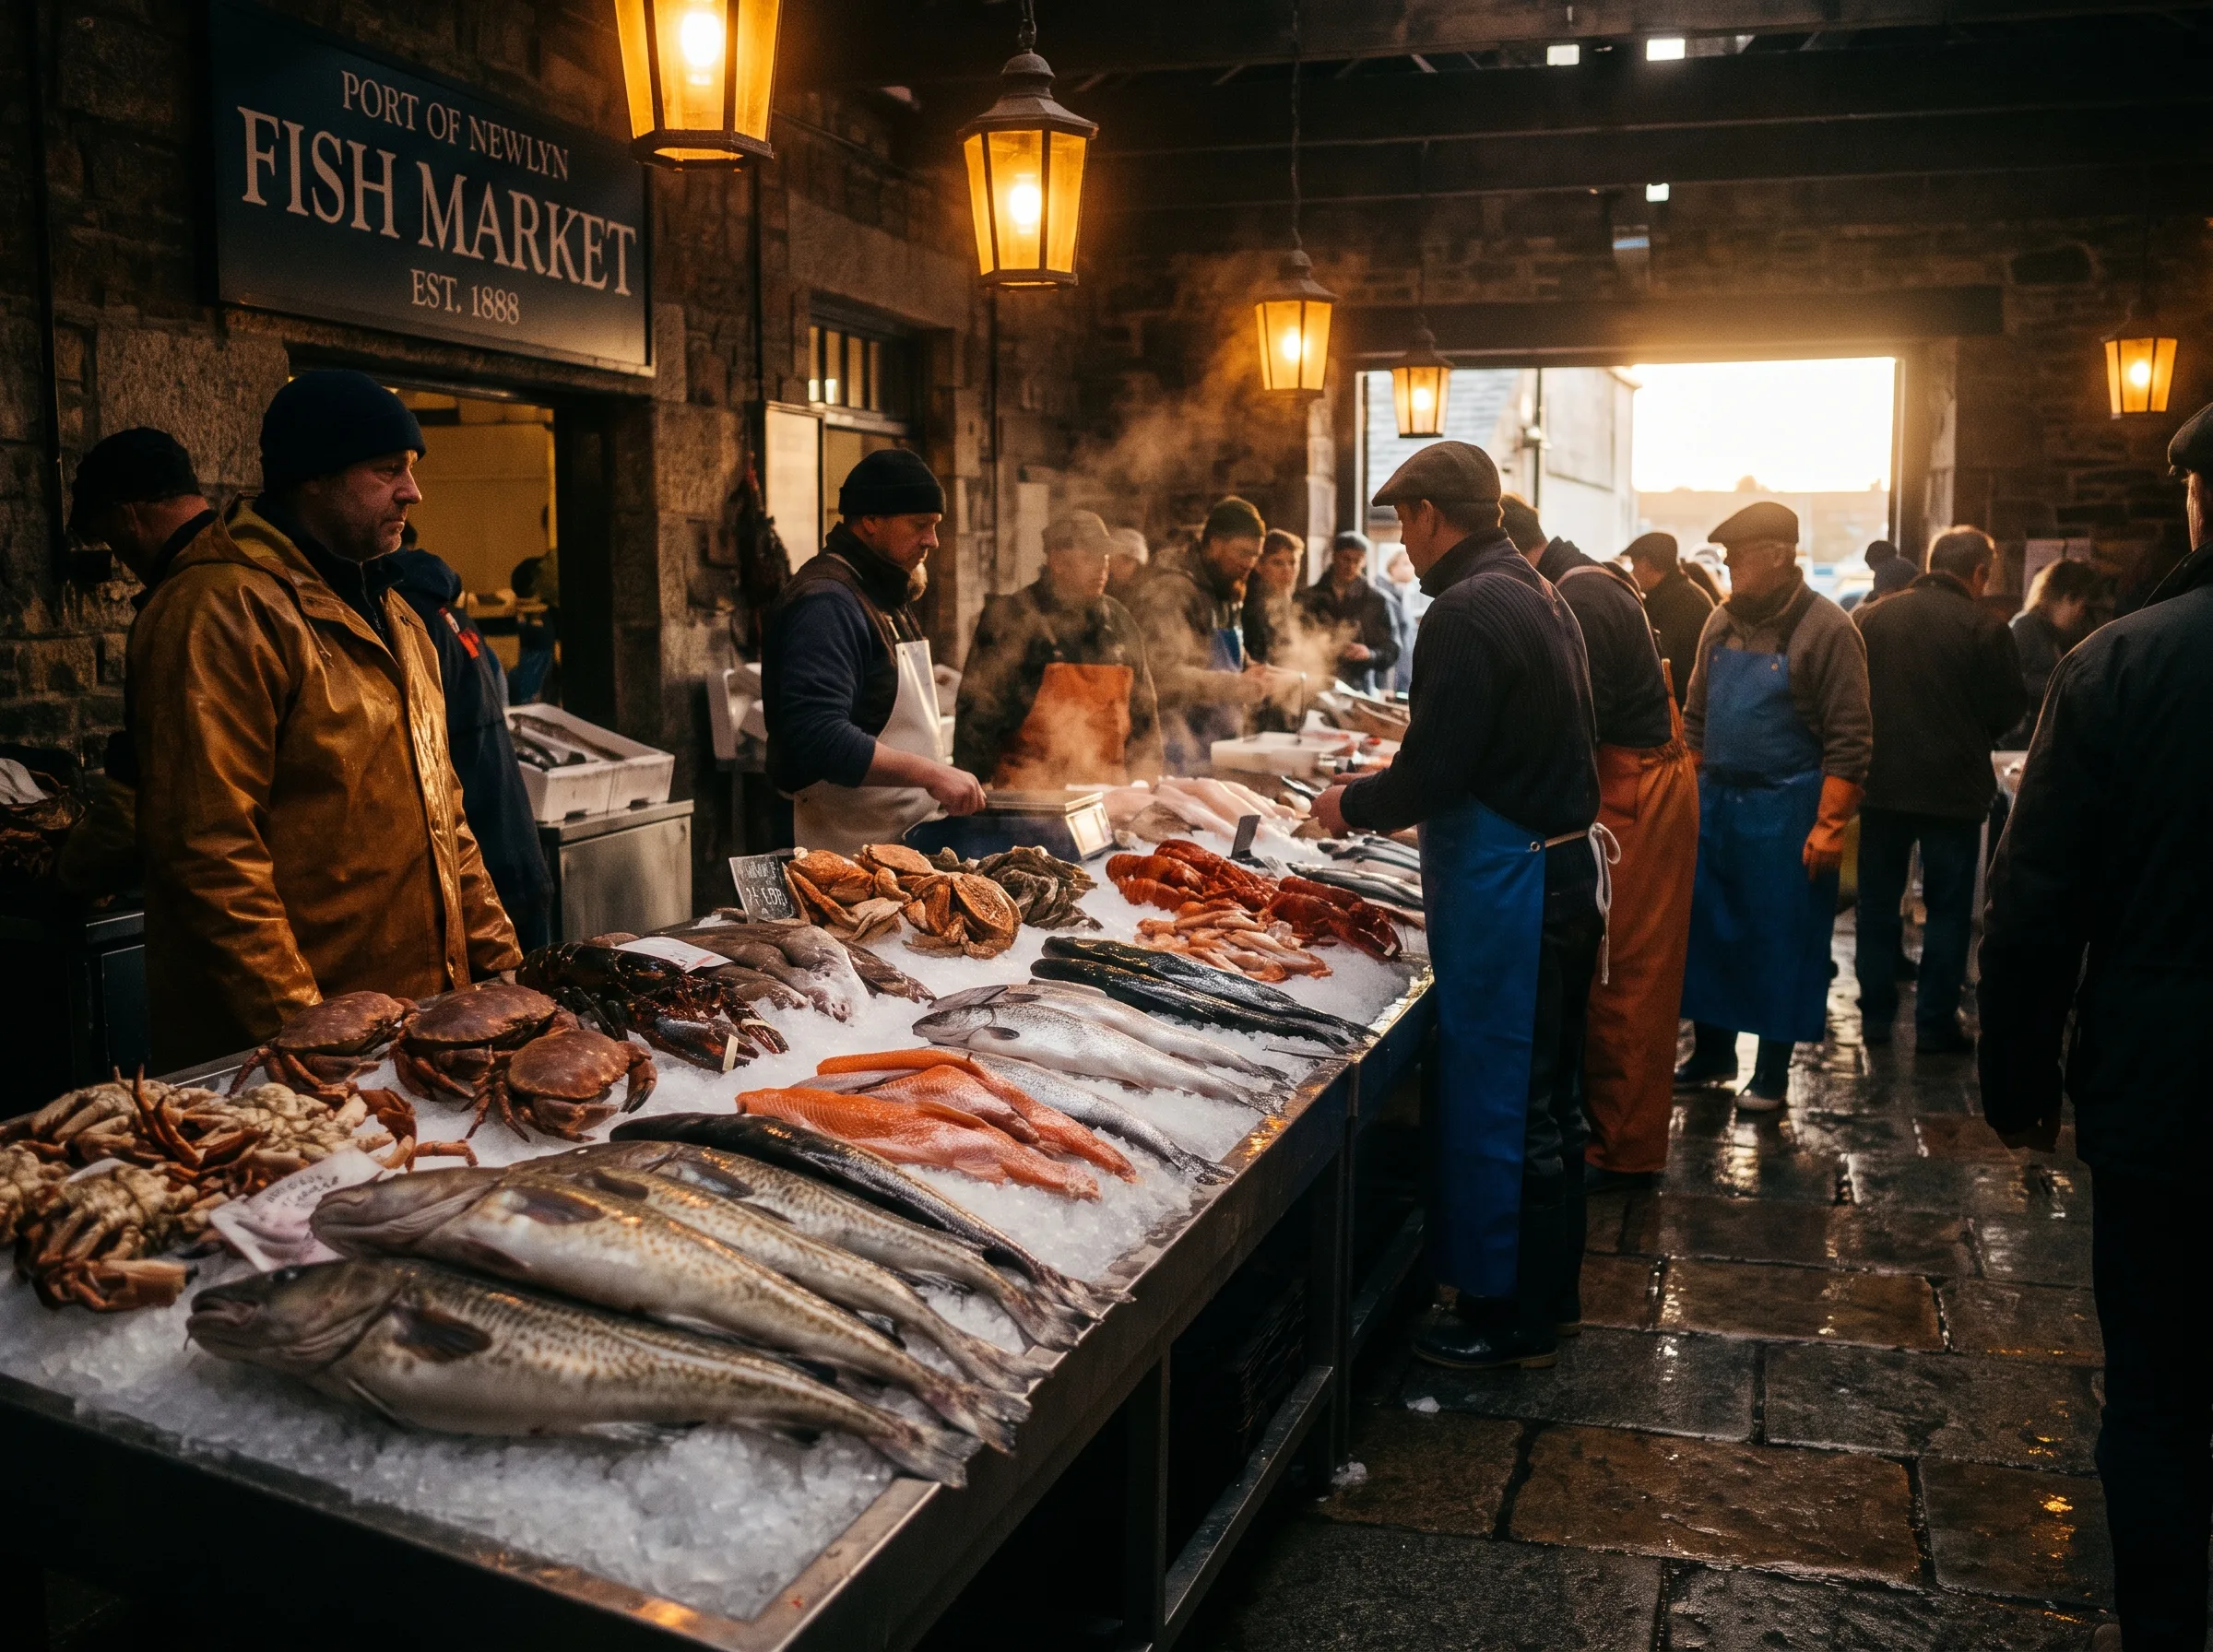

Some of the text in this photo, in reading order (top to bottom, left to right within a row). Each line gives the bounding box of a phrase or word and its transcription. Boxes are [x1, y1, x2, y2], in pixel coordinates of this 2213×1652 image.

[341, 70, 568, 181] PORT OF NEWLYN
[237, 106, 636, 296] FISH MARKET
[410, 268, 519, 324] EST. 1888
